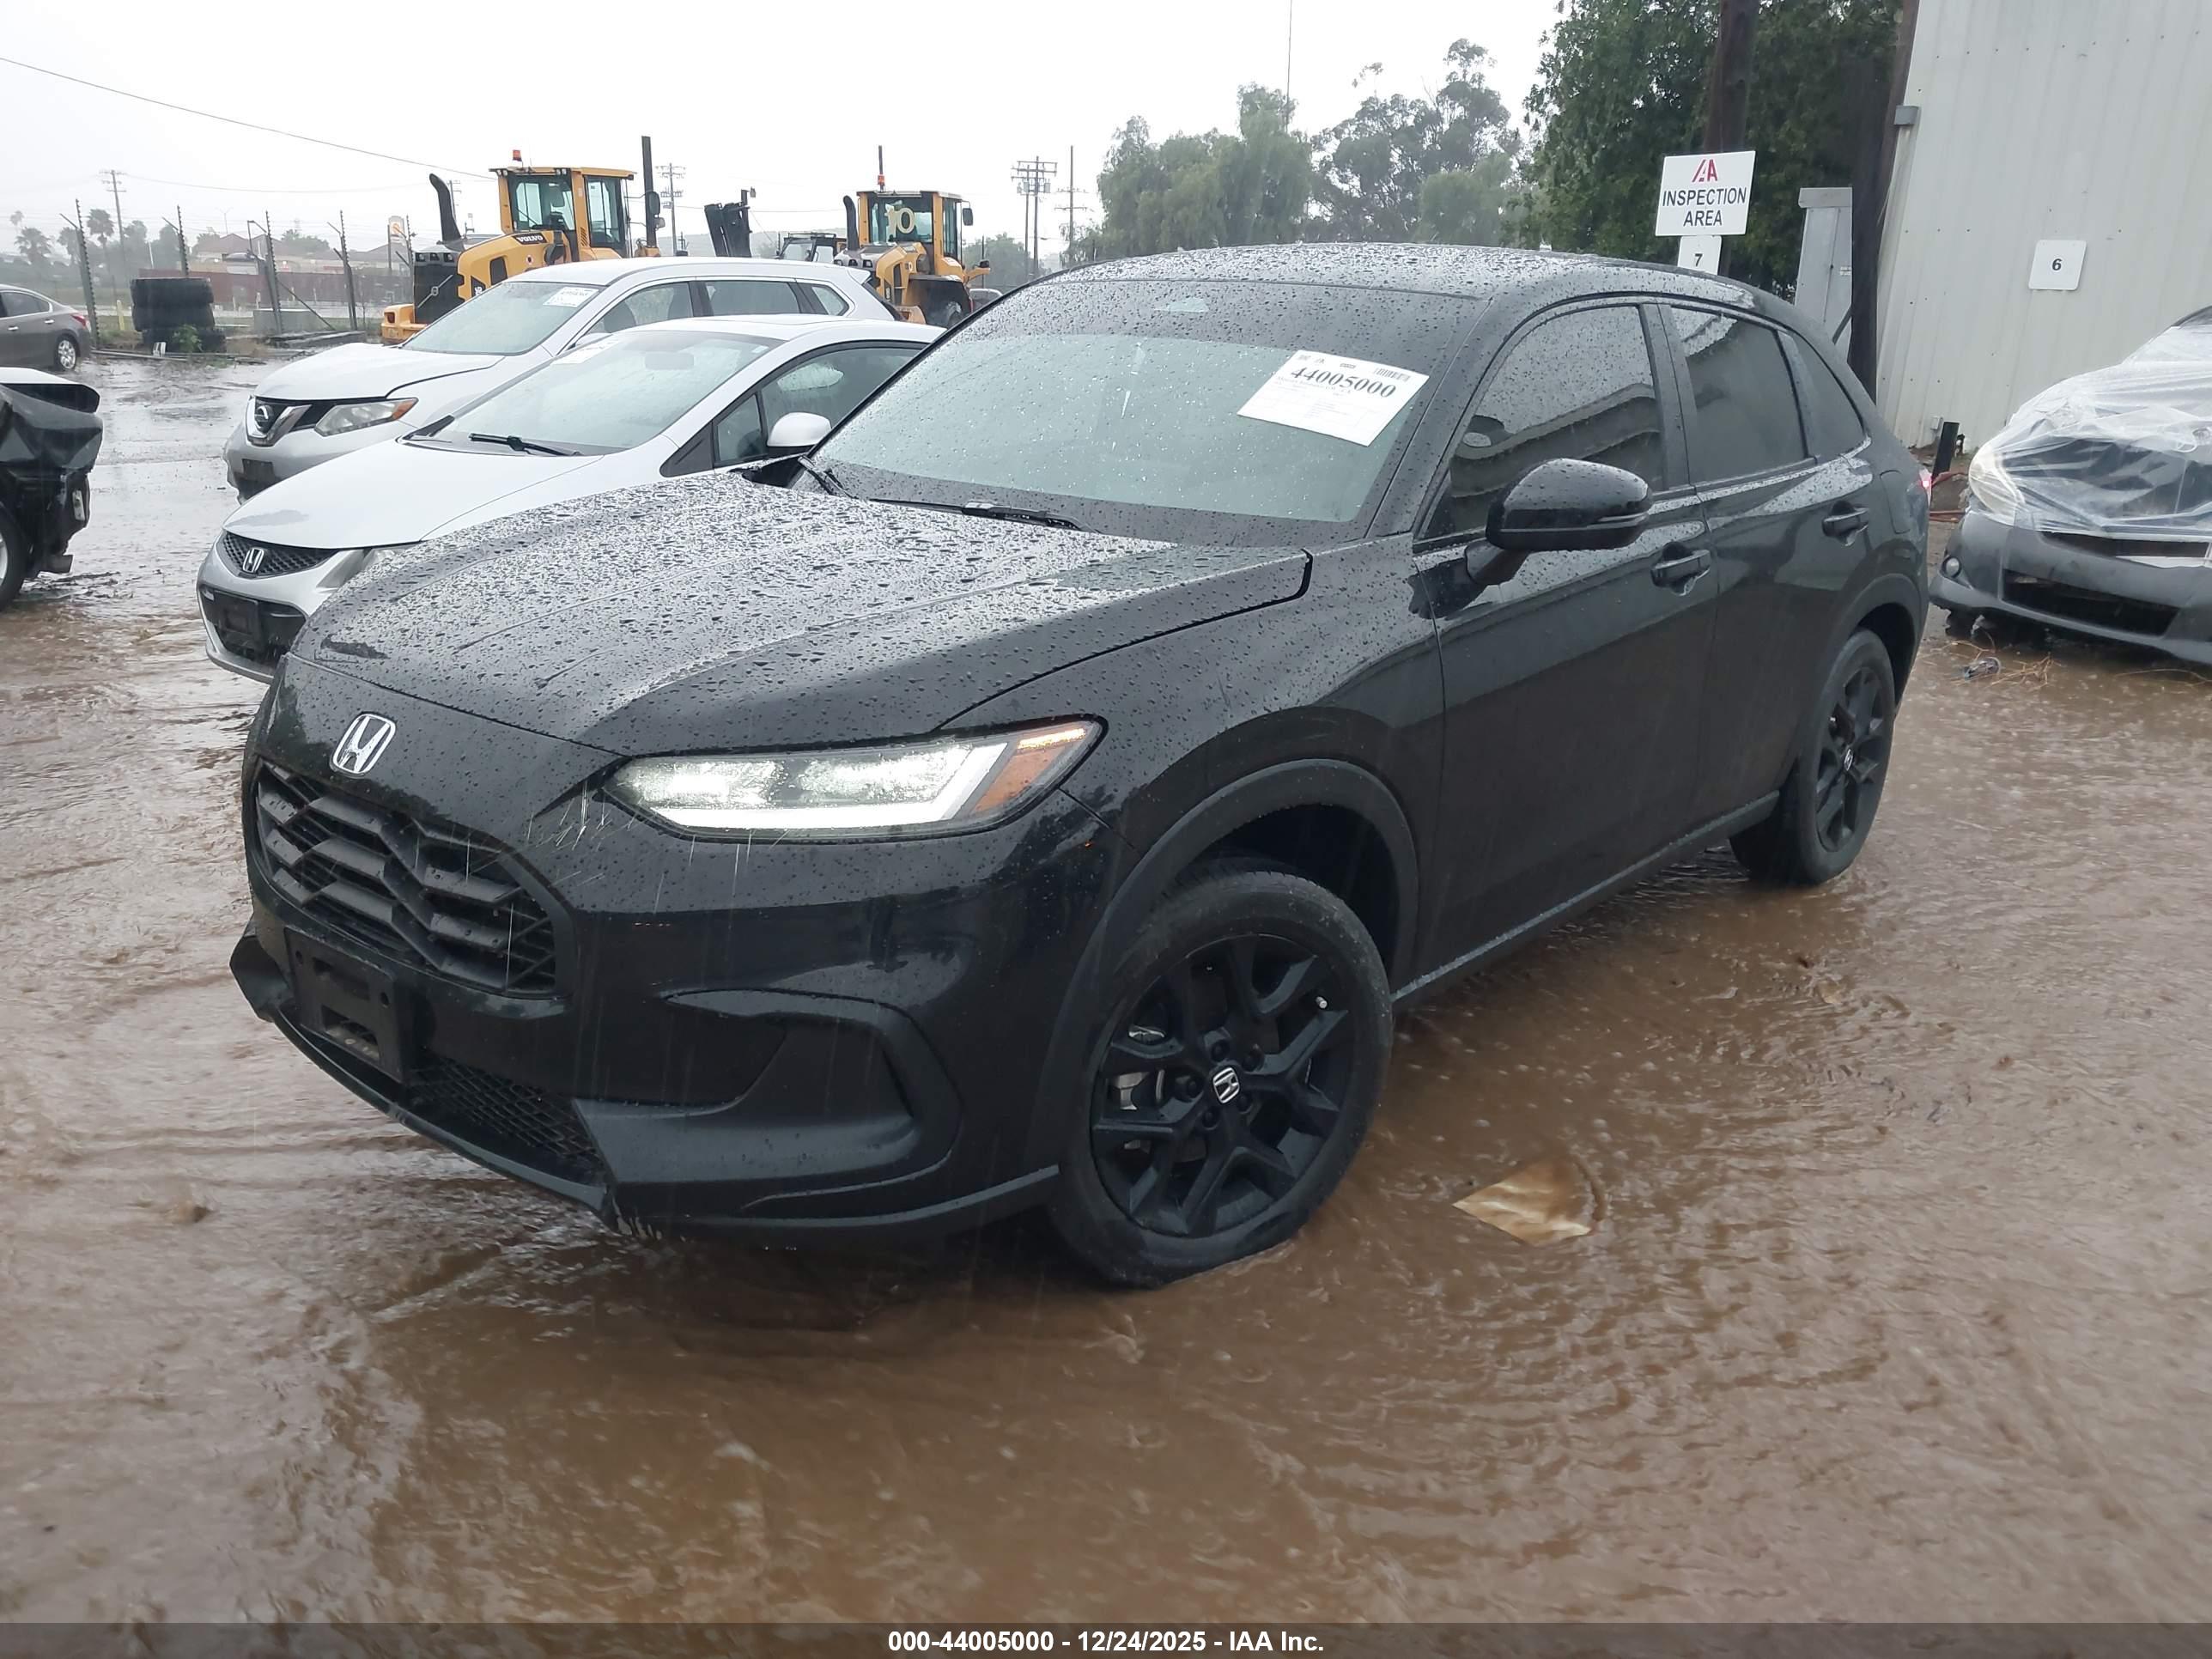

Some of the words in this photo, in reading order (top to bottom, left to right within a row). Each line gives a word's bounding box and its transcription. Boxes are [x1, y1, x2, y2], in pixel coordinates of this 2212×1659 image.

[1662, 187, 1747, 207] INSPECTION
[1683, 210, 1723, 227] AREA
[516, 234, 544, 243] VOLVO
[1694, 252, 1704, 267] 7
[2051, 258, 2063, 271] 6
[1291, 367, 1397, 398] 44005000
